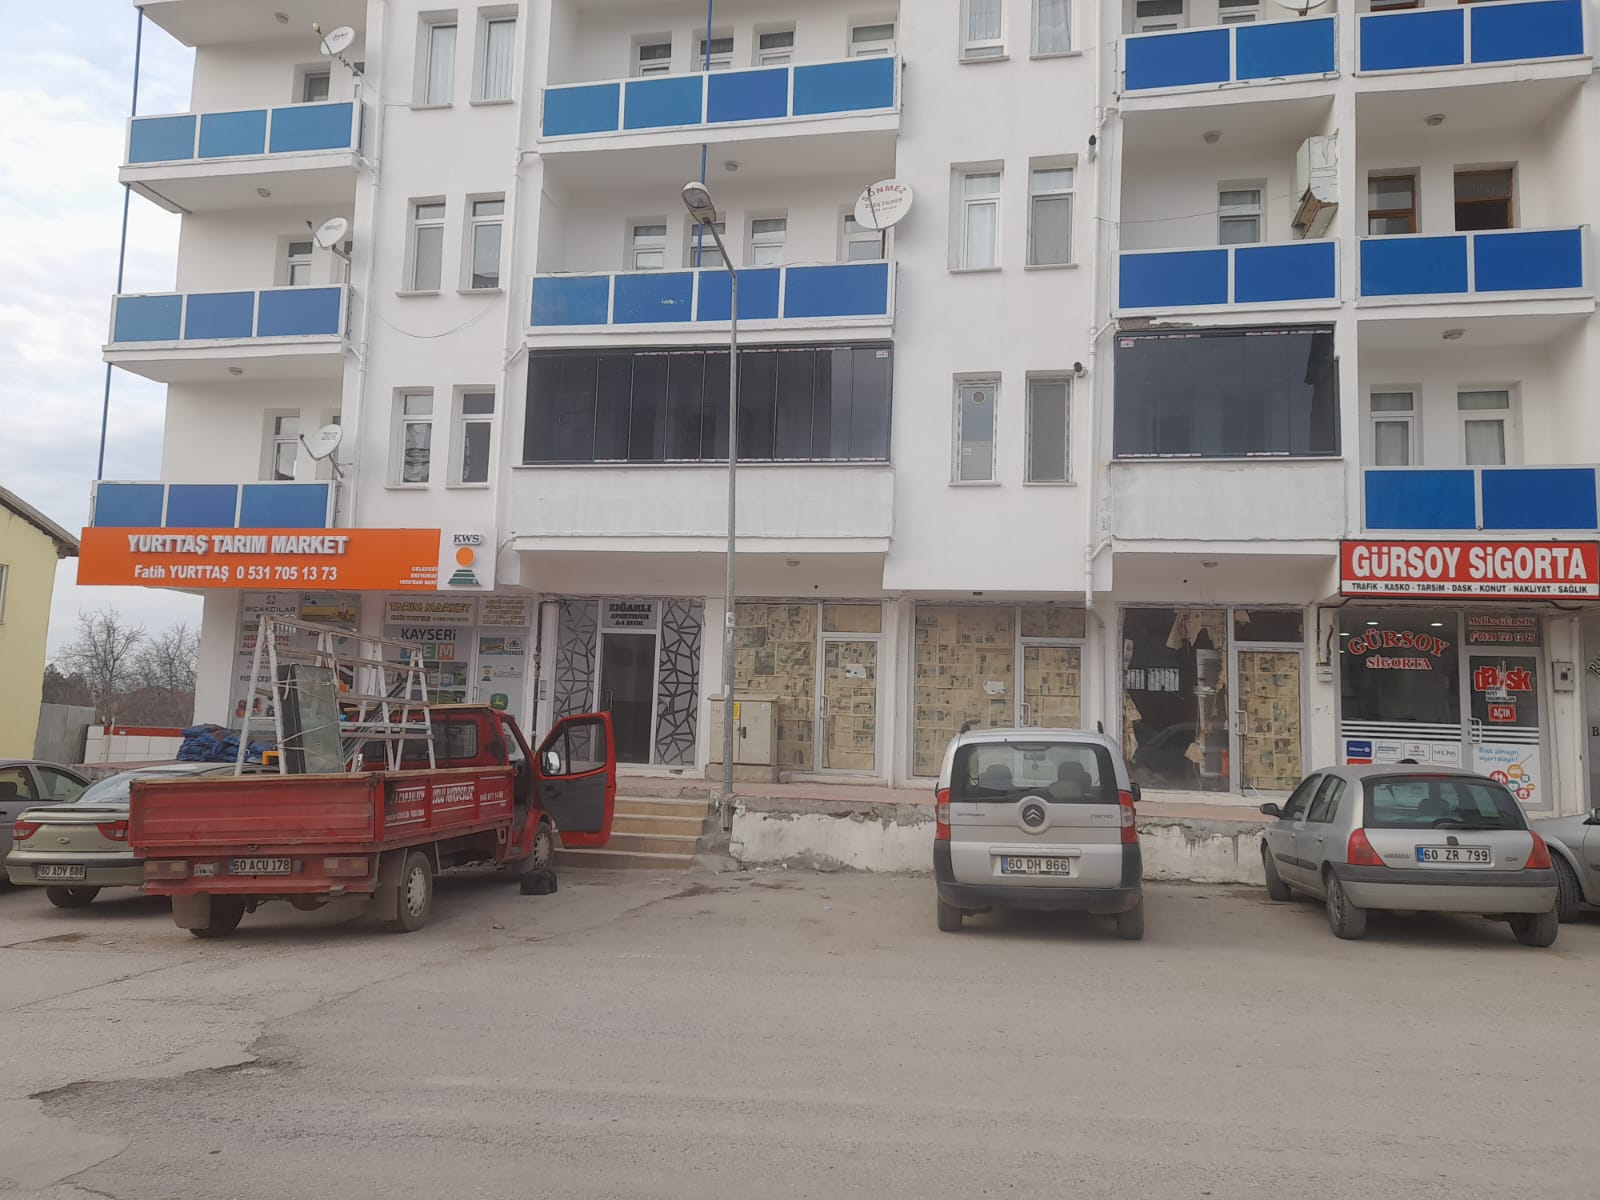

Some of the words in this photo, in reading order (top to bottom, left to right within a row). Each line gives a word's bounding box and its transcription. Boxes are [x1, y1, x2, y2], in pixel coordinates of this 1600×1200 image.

[128, 534, 209, 555] YURTTAŞ
[211, 535, 268, 553] TARIM
[271, 535, 349, 554] MARKET
[453, 534, 480, 543] KWS
[1352, 545, 1461, 579] GÜRSOY
[134, 564, 165, 579] Fatih
[169, 565, 229, 582] YURTTAŞ
[236, 565, 244, 580] 0
[248, 565, 271, 580] 531
[274, 566, 298, 580] 705
[302, 566, 317, 580] 13
[321, 566, 337, 580] 73
[1384, 583, 1411, 591] KASKO
[1452, 584, 1473, 592] DASK
[1479, 584, 1507, 593] KONUT
[1558, 584, 1588, 594] SAĞLIK
[1348, 628, 1450, 658] GÜRSOY
[1493, 707, 1512, 719] AÇIK
[1424, 849, 1438, 860] 60
[1446, 850, 1460, 861] ZR
[1466, 850, 1488, 862] 799
[41, 865, 50, 876] 60
[233, 860, 246, 871] 60
[248, 859, 269, 871] ACU
[271, 859, 290, 870] 178
[1008, 858, 1023, 869] 60
[1026, 859, 1042, 870] DH
[1046, 859, 1068, 871] 866
